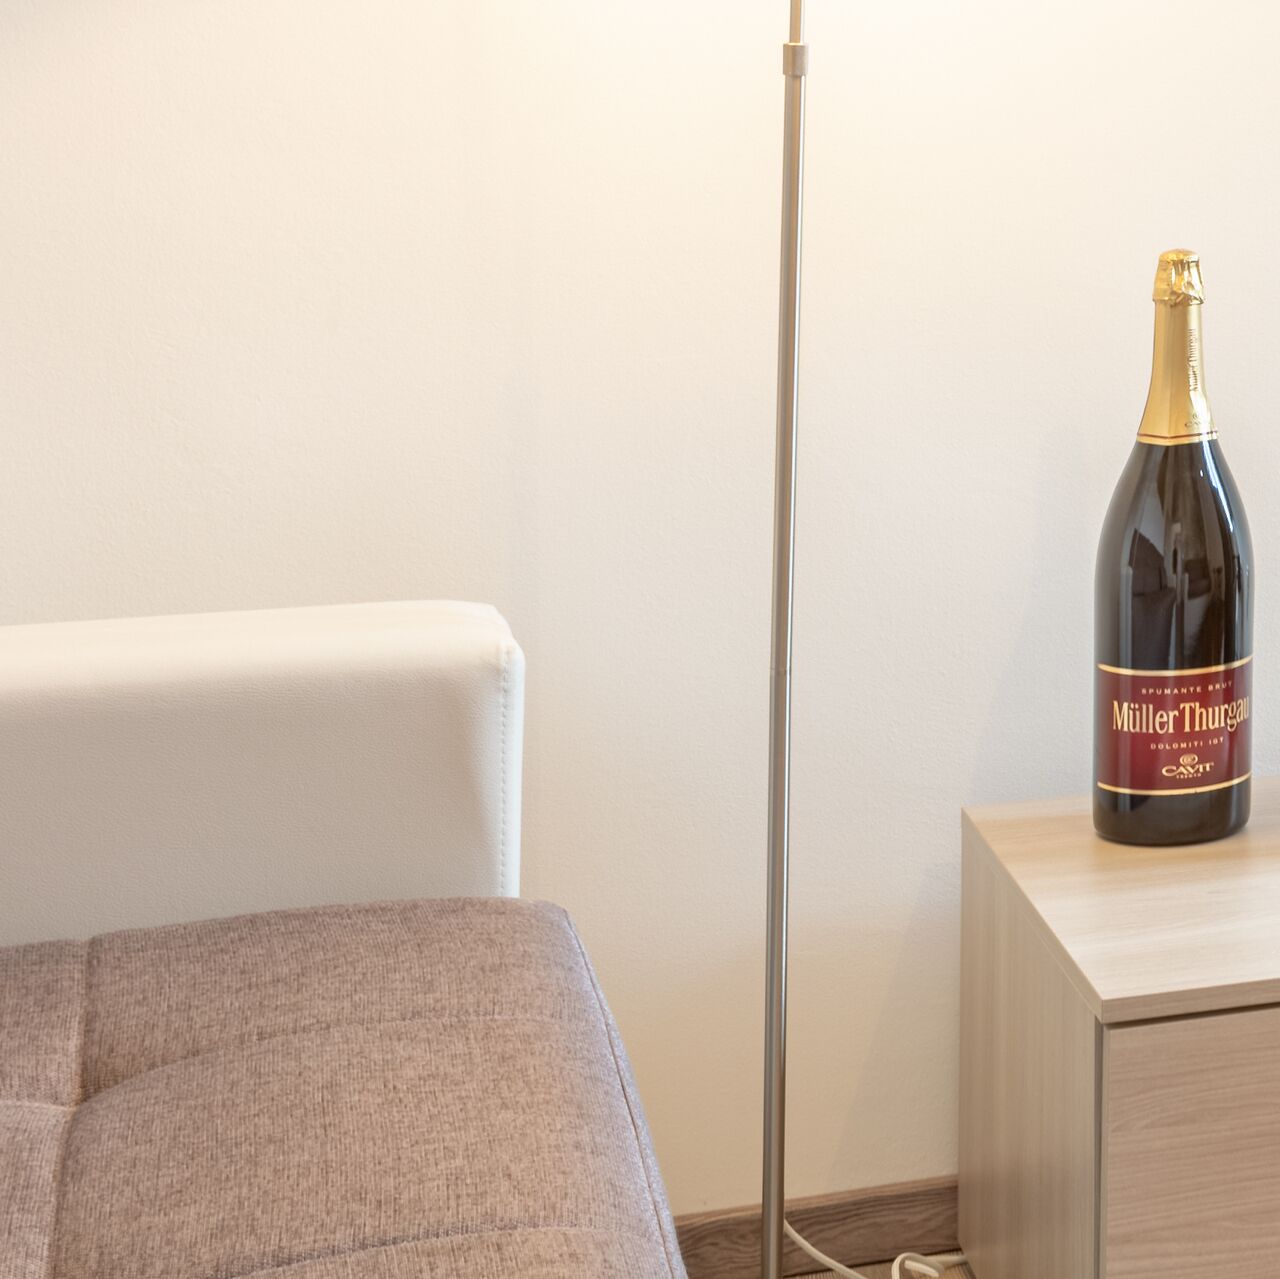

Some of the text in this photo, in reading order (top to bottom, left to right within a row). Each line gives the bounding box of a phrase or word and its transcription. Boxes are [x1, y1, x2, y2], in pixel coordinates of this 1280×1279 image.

[1141, 680, 1233, 695] SPUMANTE BRUT
[1113, 696, 1250, 735] Müller Thurgau
[1150, 736, 1224, 750] DOLOMITI IGT
[1161, 762, 1214, 777] CAVIT
